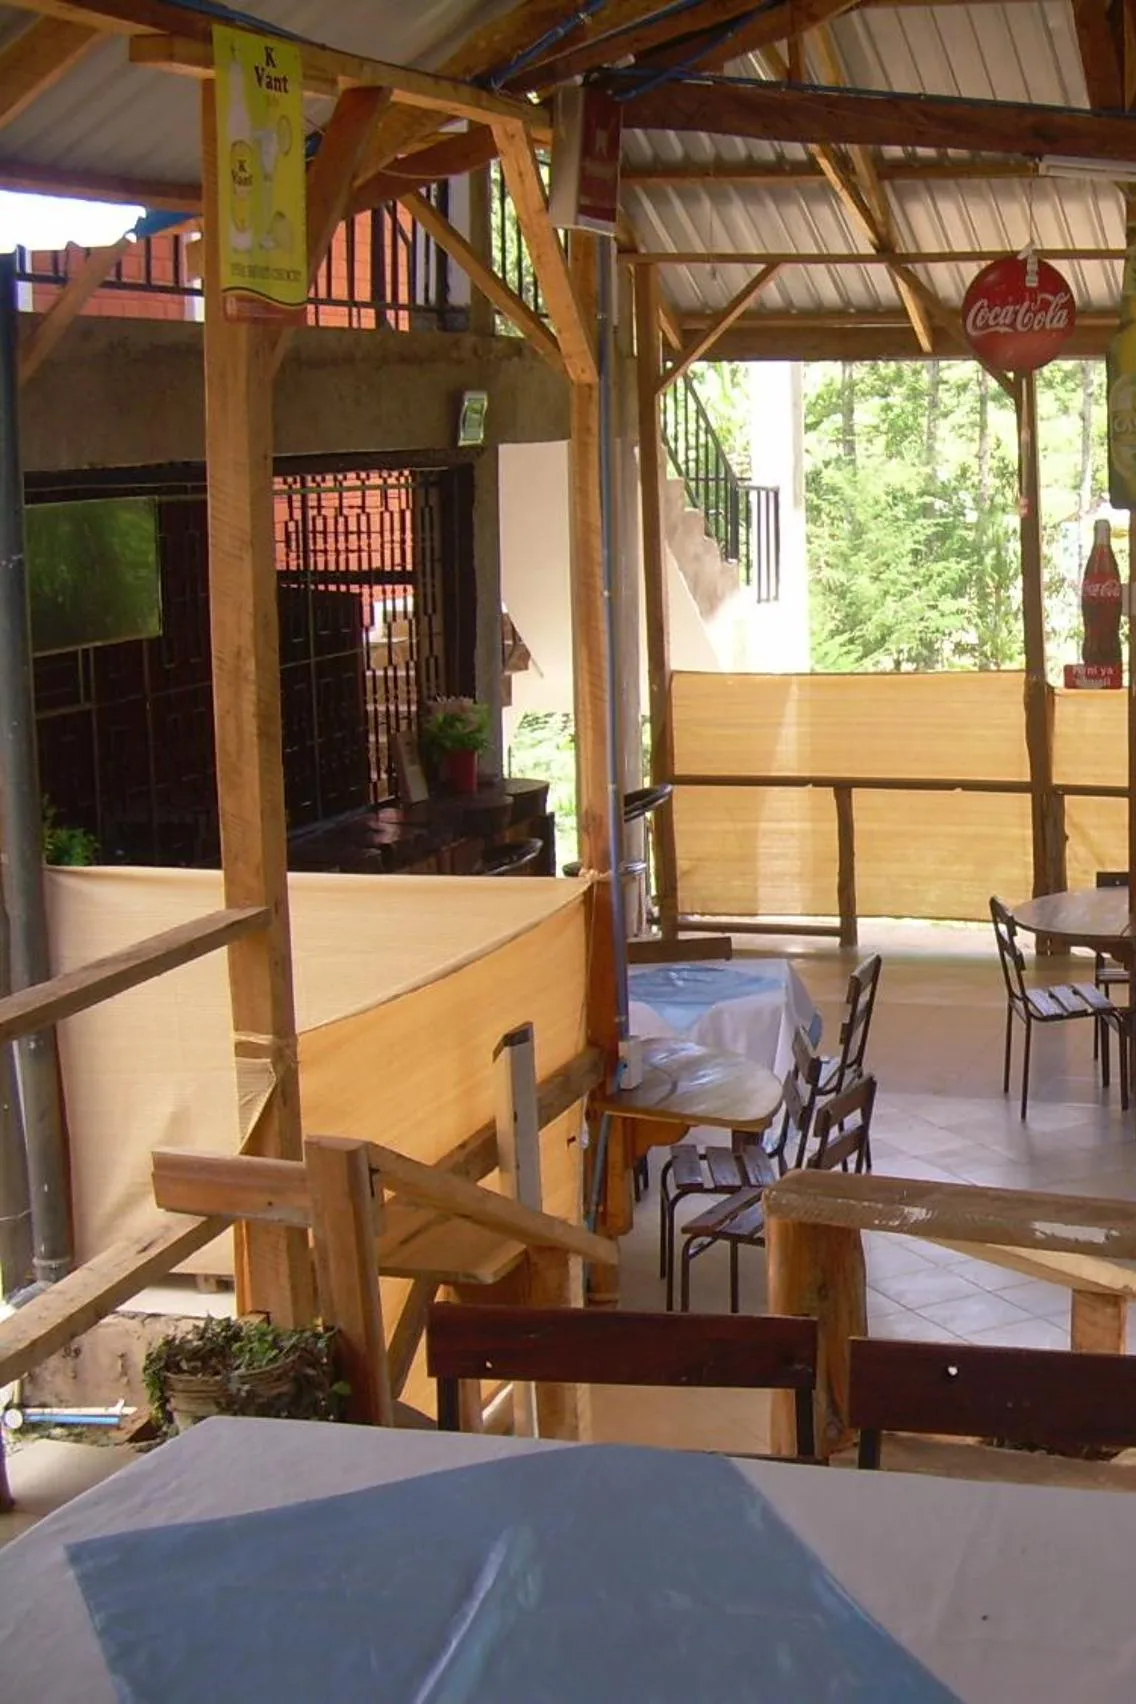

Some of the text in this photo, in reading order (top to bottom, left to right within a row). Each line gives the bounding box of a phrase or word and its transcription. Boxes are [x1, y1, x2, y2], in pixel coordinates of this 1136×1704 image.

[264, 46, 277, 68] K
[254, 64, 289, 94] Vant
[966, 292, 1070, 336] Coca-Cola
